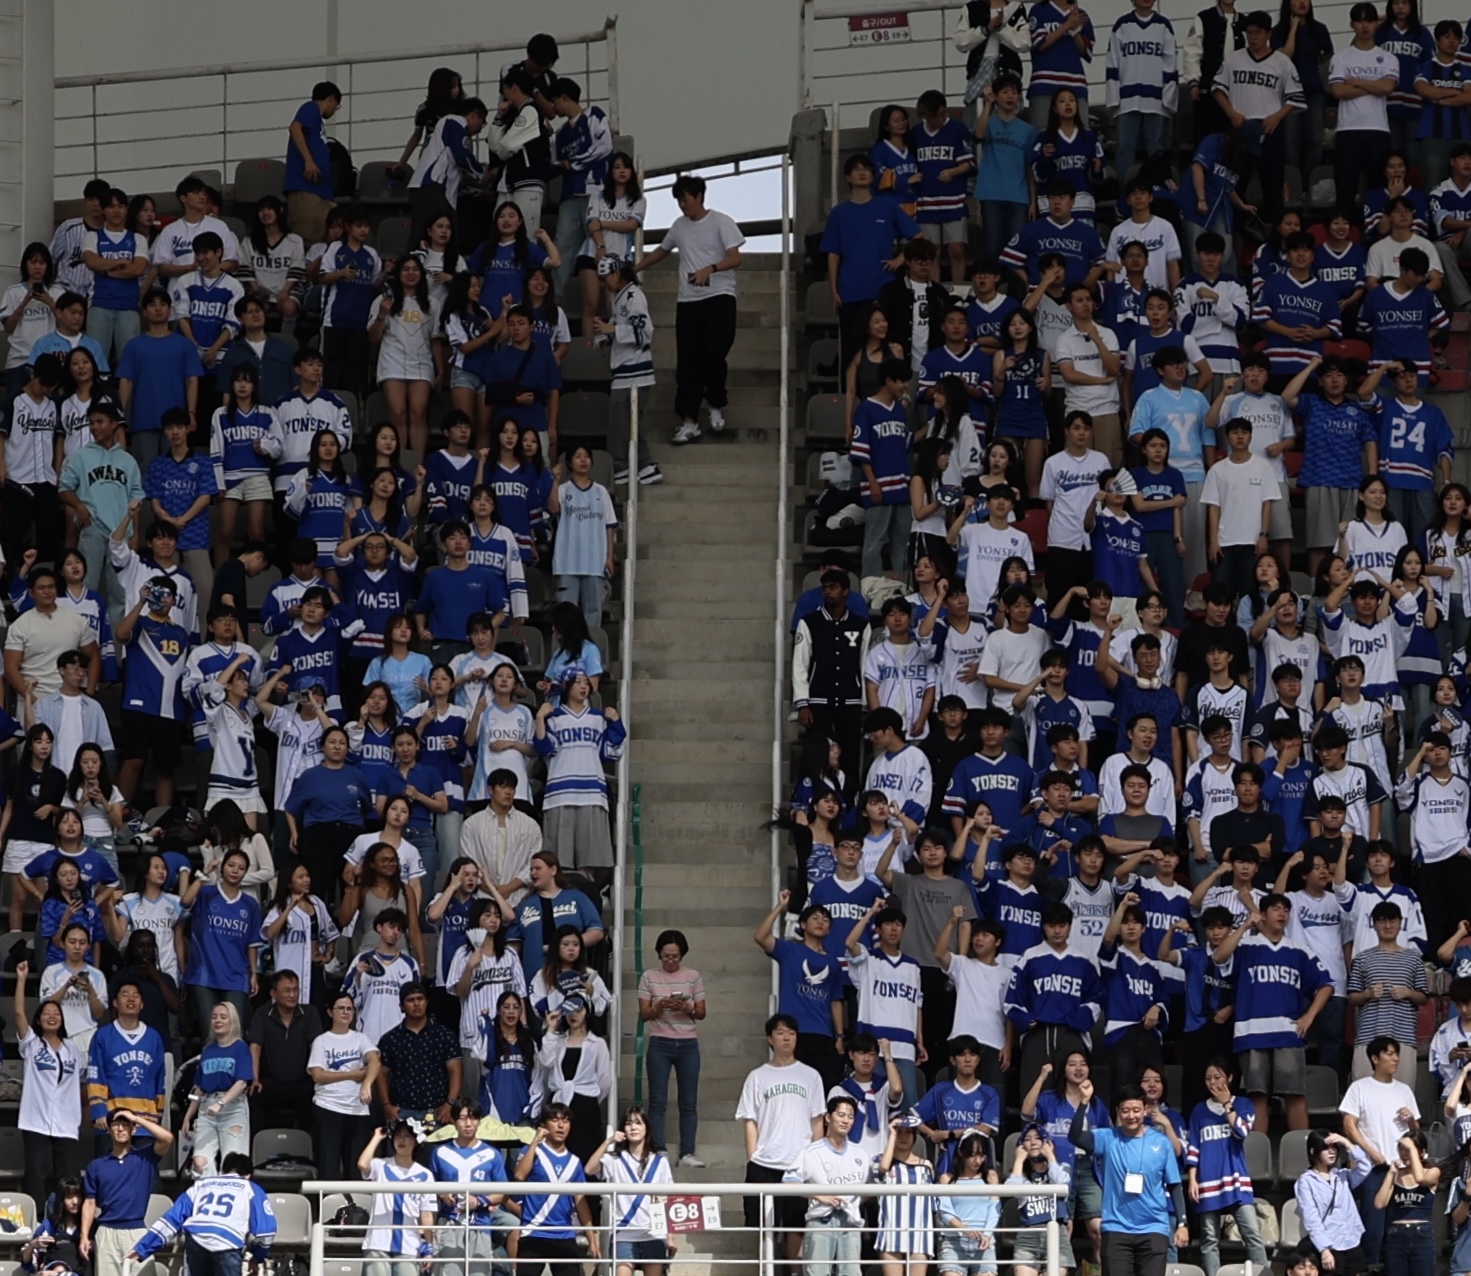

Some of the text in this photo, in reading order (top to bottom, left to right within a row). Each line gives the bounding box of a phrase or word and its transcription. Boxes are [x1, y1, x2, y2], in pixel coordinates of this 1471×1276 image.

[1233, 70, 1279, 89] YONSEI
[1378, 310, 1422, 322] YONSEI
[1391, 418, 1425, 452] 24
[844, 632, 859, 646] Y
[161, 640, 179, 655] 18
[972, 774, 1019, 792] YONSEI
